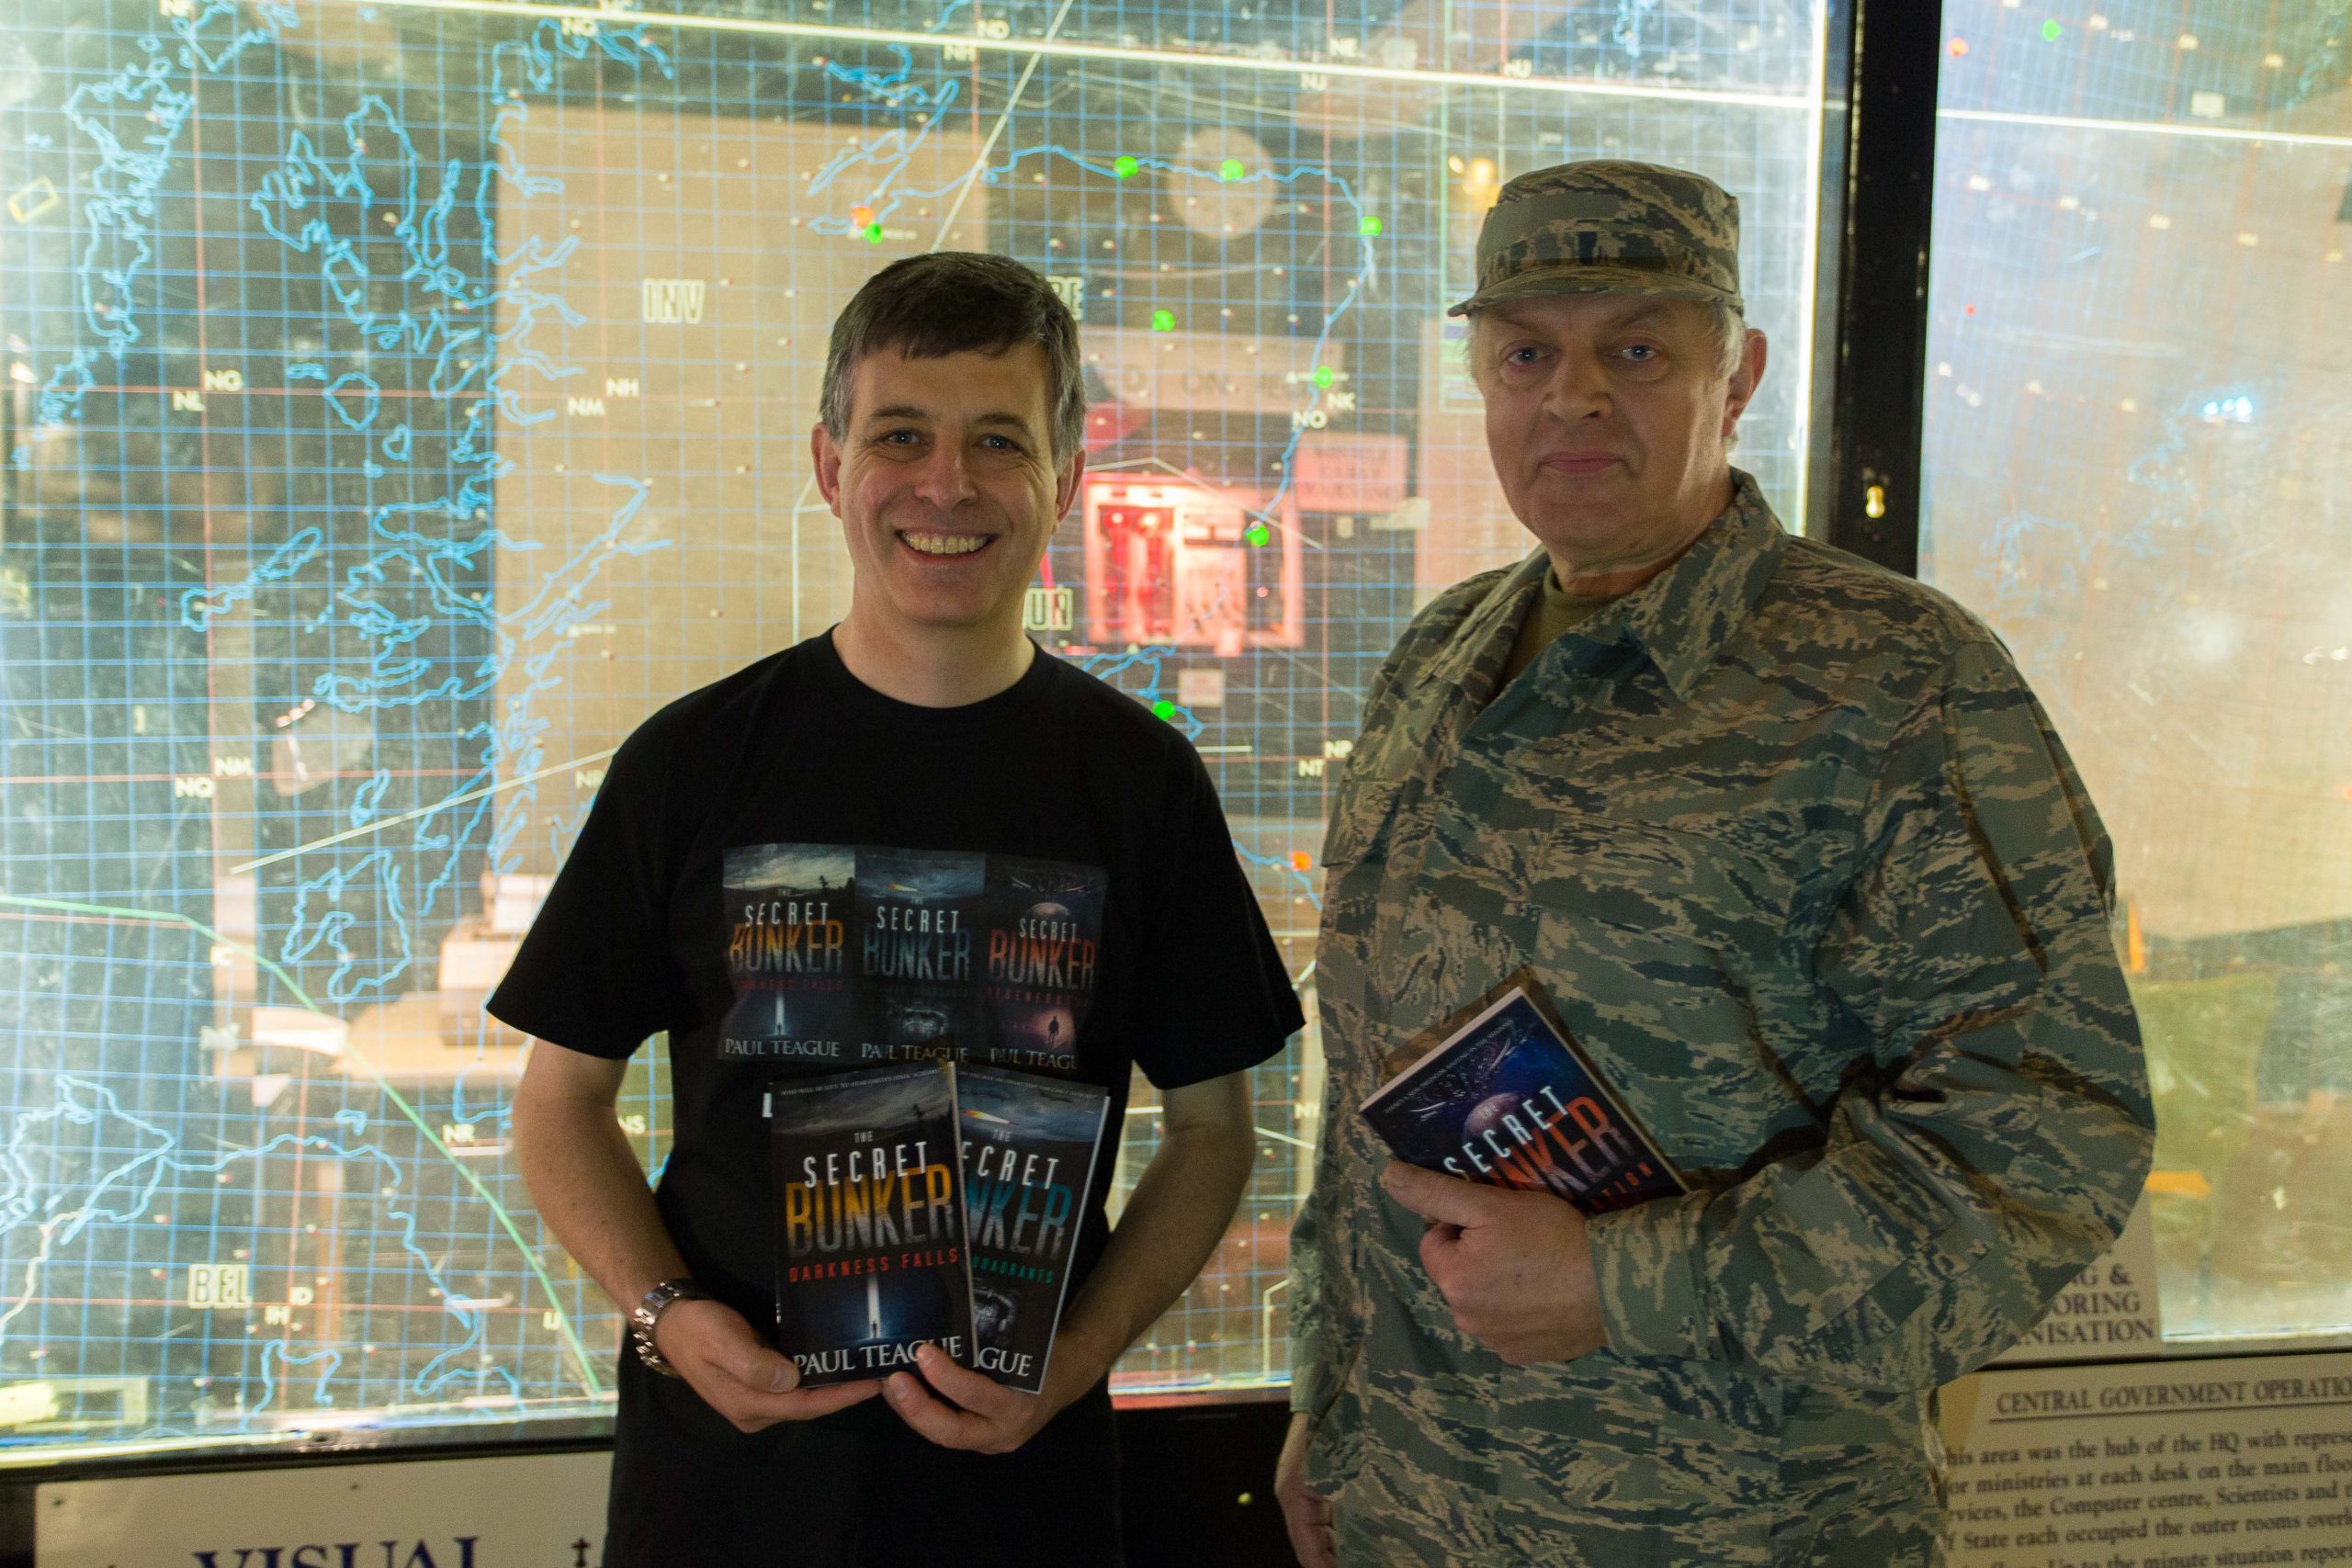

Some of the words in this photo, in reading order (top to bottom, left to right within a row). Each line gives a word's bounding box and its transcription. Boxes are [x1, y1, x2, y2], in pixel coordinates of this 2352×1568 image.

[744, 901, 830, 927] SECRET
[876, 905, 960, 934] SECRET
[1019, 918, 1079, 943] SECRET
[728, 919, 845, 975] BUNKER
[862, 922, 972, 981] BUNKER
[987, 928, 1097, 990] BUNKER
[724, 1037, 766, 1055] PAUL
[770, 1040, 841, 1058] TEAGUE
[861, 1042, 897, 1060] PAUL
[854, 1131, 874, 1144] THE
[802, 1141, 930, 1189] SECRET
[785, 1162, 957, 1258] BUNKER
[788, 1256, 890, 1283] DARKNESS
[900, 1247, 959, 1269] FALLS
[2052, 1290, 2141, 1317] ORING
[793, 1345, 856, 1377] PAUL
[858, 1335, 963, 1369] TEAGE
[1996, 1388, 2092, 1416] CENTRAL
[2099, 1380, 2248, 1409] GOVERNMENT
[1980, 1449, 2019, 1465] area
[2028, 1446, 2062, 1462] was
[2068, 1438, 2098, 1459] the
[2104, 1435, 2140, 1458] hub
[2145, 1433, 2167, 1456] of
[2173, 1432, 2201, 1453] the
[2209, 1431, 2240, 1453] HQ
[2247, 1428, 2288, 1449] with
[1976, 1471, 2069, 1494] ministries
[2075, 1472, 2093, 1487] at
[2099, 1463, 2143, 1486] each
[2149, 1461, 2189, 1483] desk
[2198, 1466, 2221, 1480] on
[2227, 1458, 2256, 1478] the
[2263, 1455, 2309, 1476] main
[2013, 1497, 2044, 1517] the
[2050, 1495, 2142, 1519] Computer
[2216, 1483, 2299, 1505] Scientists
[2306, 1479, 2338, 1500] and
[2015, 1524, 2059, 1547] each
[2065, 1517, 2149, 1545] occupied
[2155, 1517, 2183, 1537] the
[2190, 1518, 2239, 1535] outer
[2245, 1517, 2301, 1531] rooms
[2215, 1546, 2294, 1566] situation
